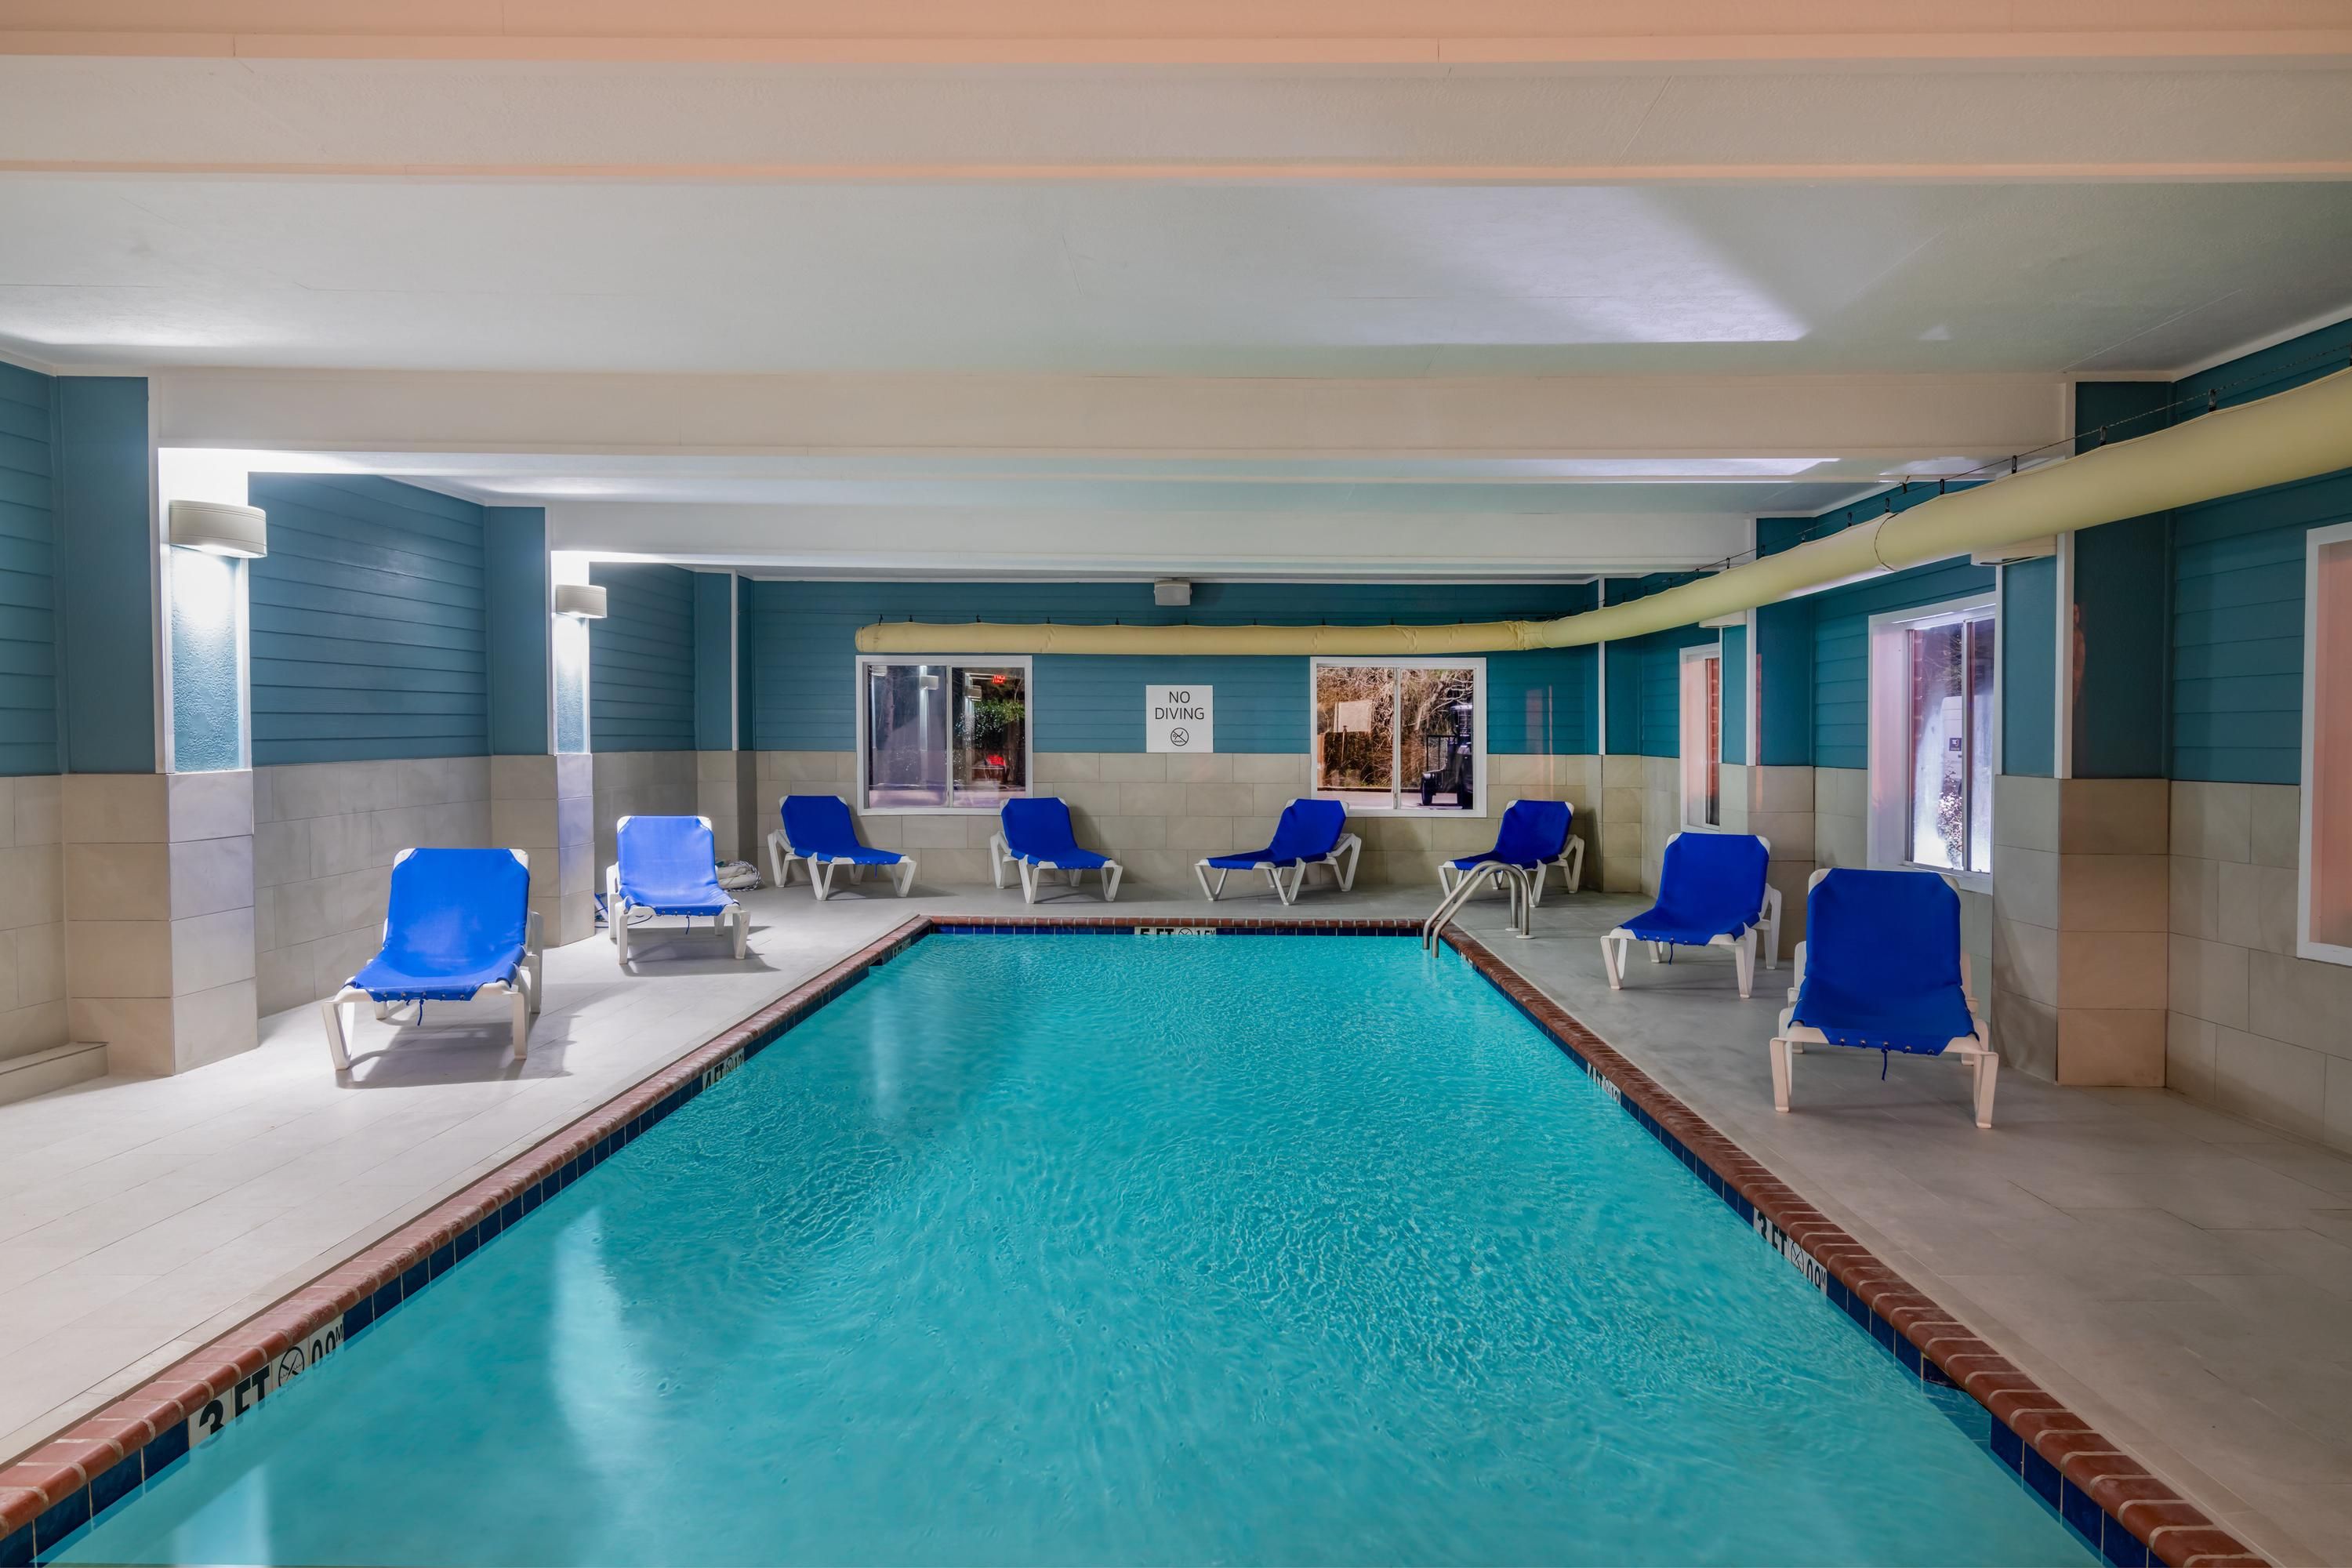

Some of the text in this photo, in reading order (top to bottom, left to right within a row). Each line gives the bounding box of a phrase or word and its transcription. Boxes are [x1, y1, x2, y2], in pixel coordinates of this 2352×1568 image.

[1169, 691, 1191, 704] NO
[1155, 707, 1205, 720] DIVING
[714, 1062, 724, 1083] FT
[1772, 1222, 1788, 1257] FT
[198, 1399, 225, 1436] 3
[234, 1365, 270, 1417] FT
